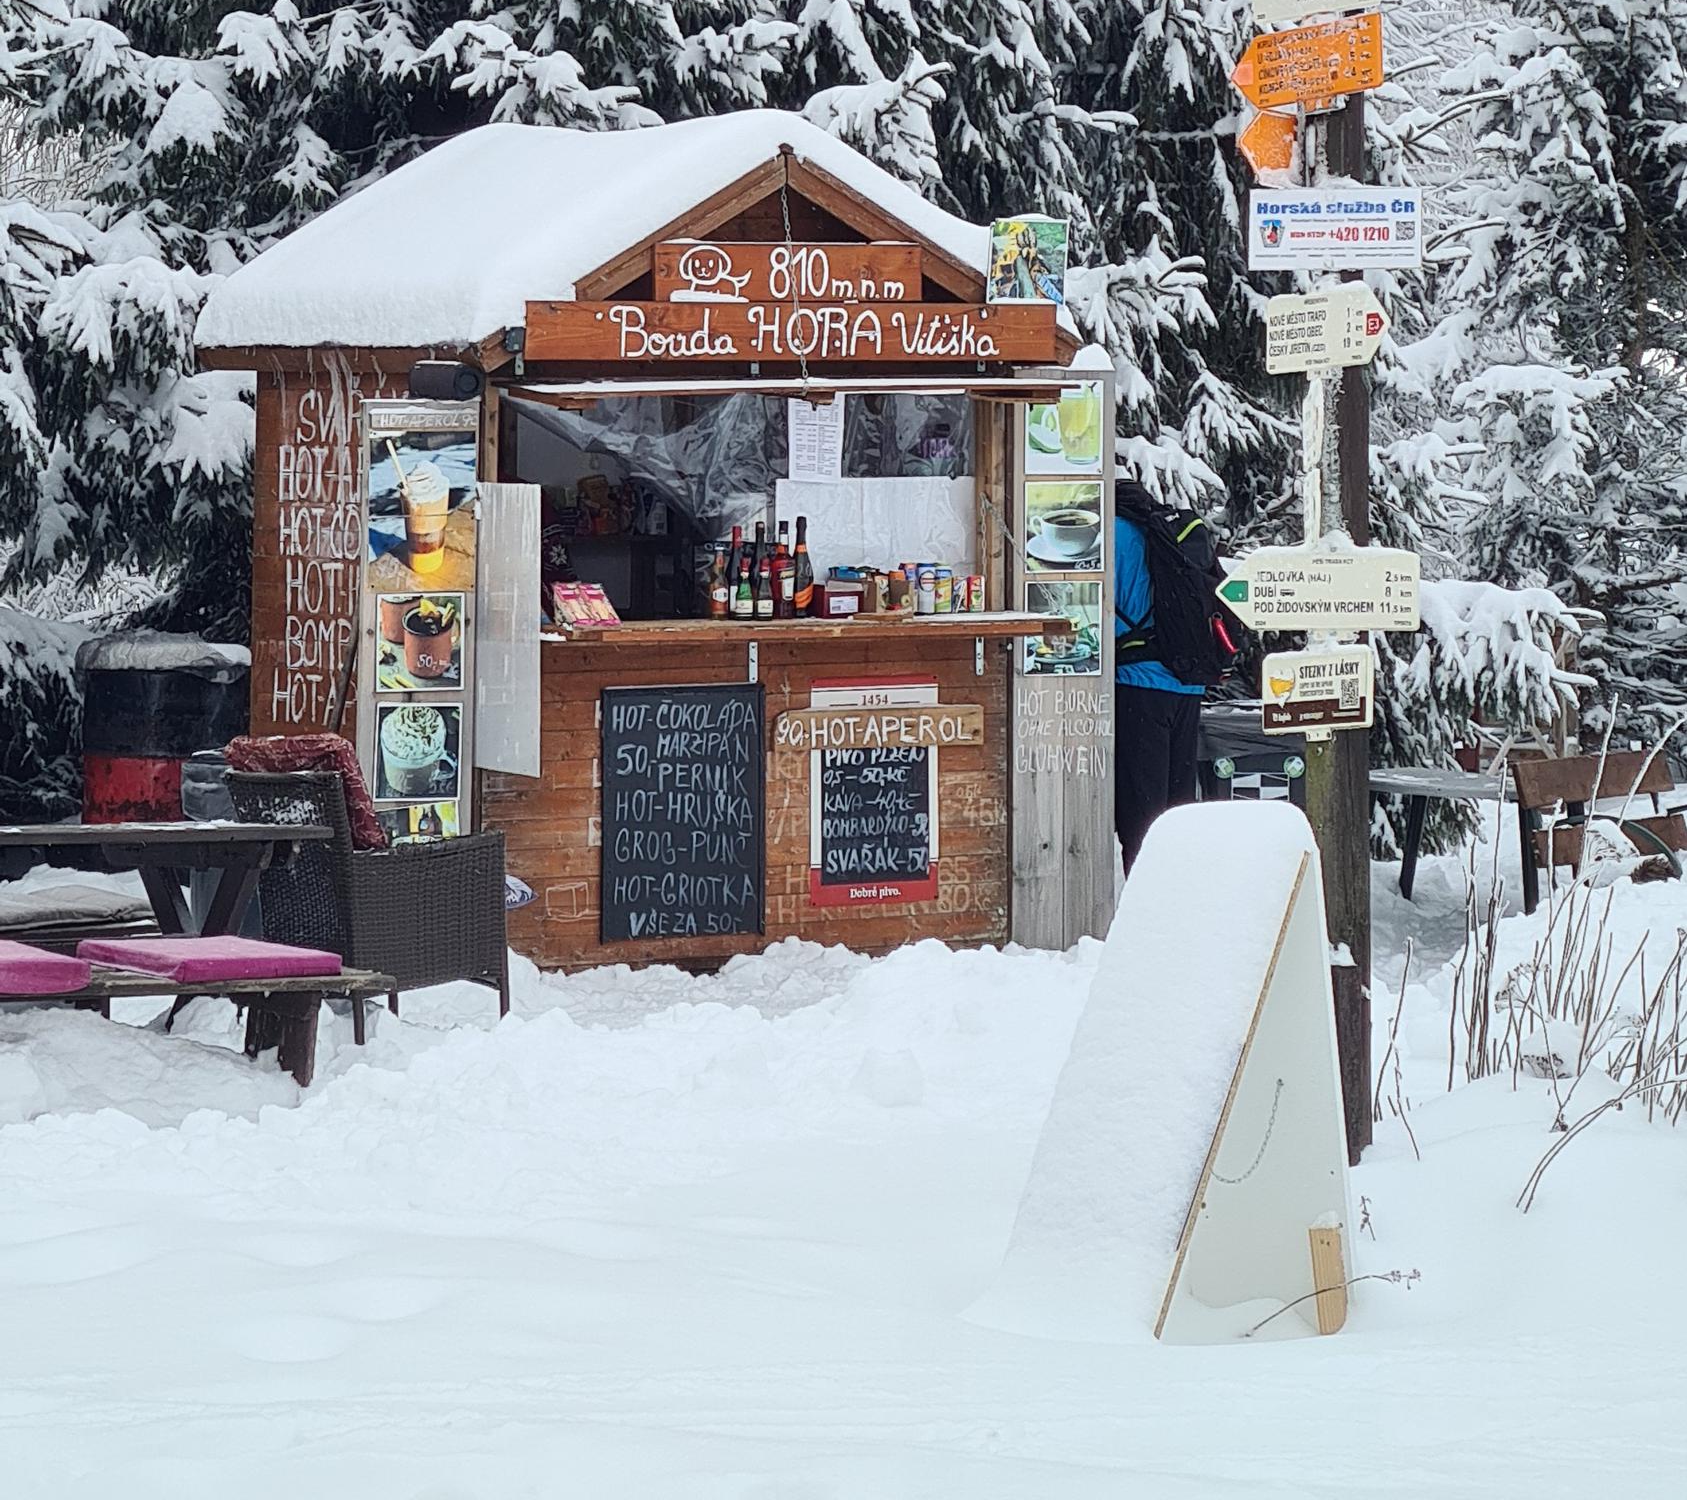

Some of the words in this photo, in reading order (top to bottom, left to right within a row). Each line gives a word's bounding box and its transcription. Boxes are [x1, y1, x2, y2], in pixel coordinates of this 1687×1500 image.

[1256, 201, 1322, 215] Horská
[1326, 200, 1387, 214] služba
[1391, 198, 1416, 214] ČR
[1328, 227, 1359, 242] +420
[1363, 226, 1390, 241] 1210
[769, 246, 830, 299] 810
[748, 305, 882, 358] HORA
[892, 311, 1000, 357] Vitiška
[1254, 571, 1305, 583] JEDLOVKA
[1400, 572, 1412, 582] km
[1254, 584, 1277, 598] DUBÍ
[1385, 586, 1392, 598] 8
[1400, 587, 1412, 598] km
[1254, 602, 1274, 613] POD
[1276, 599, 1332, 613] ŽIDOVSKÝM
[1334, 601, 1374, 613] VRCHEM
[1400, 602, 1412, 613] km
[1299, 664, 1327, 680] STEZKY
[1328, 663, 1334, 677] Z
[1335, 658, 1360, 676] LÁSKY
[861, 694, 890, 706] 1454
[1017, 687, 1050, 717] HOT
[824, 748, 865, 768] PIVO
[823, 785, 864, 813] KÁVA
[850, 886, 878, 899] Dobré
